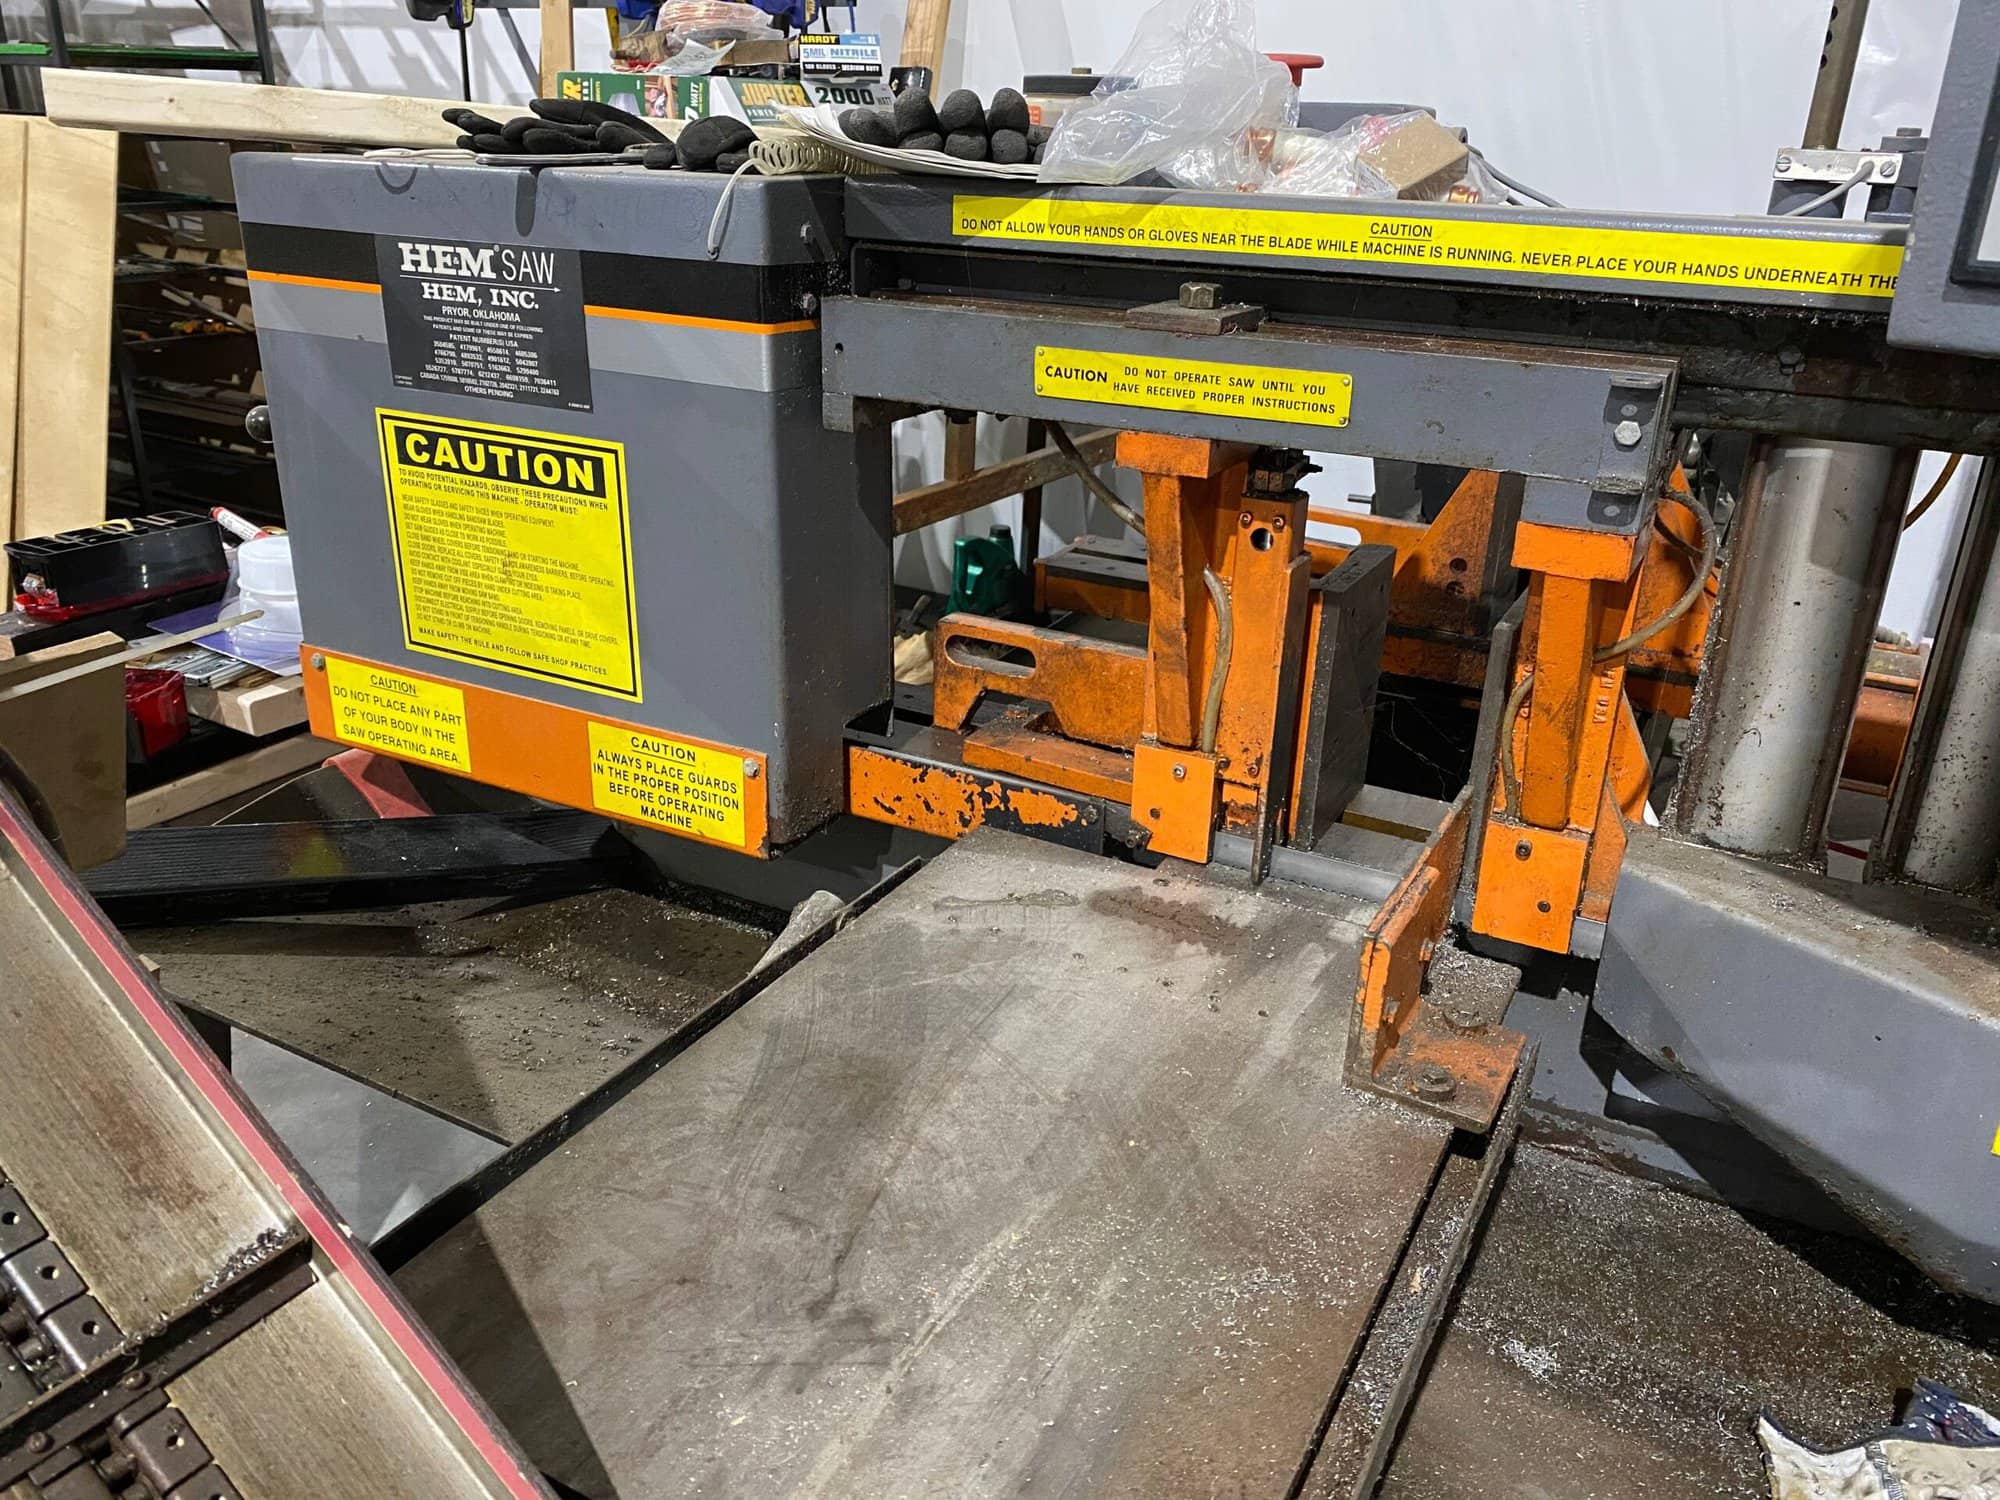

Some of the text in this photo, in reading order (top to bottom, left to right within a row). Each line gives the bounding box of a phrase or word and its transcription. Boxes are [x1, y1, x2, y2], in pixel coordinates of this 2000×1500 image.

[800, 34, 836, 44] HARDY
[830, 48, 878, 57] NITRILE
[740, 82, 808, 107] JUPITER
[814, 86, 875, 105] 2000
[1370, 223, 1432, 237] CAUTION
[500, 248, 556, 284] SAW
[961, 217, 976, 229] DO
[980, 219, 1002, 231] NOT
[1006, 220, 1045, 234] ALLOW
[1049, 223, 1080, 236] YOUR
[1084, 225, 1124, 239] HANDS
[1128, 228, 1144, 240] OR
[1148, 229, 1198, 243] GLOVES
[1201, 232, 1235, 246] NEAR
[1240, 234, 1264, 248] THE
[1269, 236, 1312, 251] BLADE
[1316, 239, 1357, 254] WHILE
[1362, 242, 1425, 258] MACHINE
[1429, 246, 1442, 259] IS
[1521, 252, 1570, 267] NEVER
[1576, 255, 1627, 271] PLACE
[1631, 258, 1676, 274] YOUR
[1681, 261, 1739, 278] HANDS
[1743, 265, 1863, 286] UNDERNEATH
[441, 305, 520, 322] PRYOR, OKLAHOMA
[489, 288, 539, 310] INC.
[449, 333, 470, 342] PATENT
[1045, 365, 1107, 382] CAUTION
[1124, 366, 1326, 395] DO NOT OPERATE SAW UNTIL YOU
[464, 385, 487, 394] OTHERS
[487, 388, 513, 398] PENDING
[1113, 382, 1335, 414] HAVE RECEIVED PROPER INSTRUCTIONS
[405, 432, 594, 491] CAUTION
[398, 467, 406, 476] TO
[407, 469, 425, 479] AVOID
[426, 472, 457, 485] POTENTIAL
[491, 483, 519, 495] OBSERVE
[521, 488, 541, 499] THESE
[542, 491, 587, 507] PRECAUTIONS
[588, 499, 608, 510] WHEN
[399, 476, 432, 489] OPERATING
[433, 482, 441, 491] OR
[443, 484, 474, 497] SERVICING
[475, 489, 489, 499] THIS
[490, 492, 519, 504] MACHINE
[524, 498, 557, 511] OPERATOR
[419, 626, 433, 636] MAKE
[436, 630, 458, 641] SAFETY
[461, 635, 472, 644] THE
[473, 638, 488, 648] RULE
[491, 642, 503, 651] AND
[505, 645, 531, 658] FOLLOW
[532, 651, 549, 662] SAFE
[551, 655, 568, 666] SHOP
[369, 673, 416, 695] CAUTION
[332, 684, 462, 727] DO NOT PLACE ANY PART
[343, 705, 455, 744] OF YOUR BODY IN THE
[343, 723, 461, 763] SAW OPERATING AREA.
[630, 736, 695, 762] CAUTION
[597, 748, 736, 793] ALWAYS PLACE GUARDS
[593, 762, 738, 810] IN THE PROPER POSITION
[609, 781, 724, 822] BEFORE OPERATING
[640, 804, 691, 828] MACHINE
